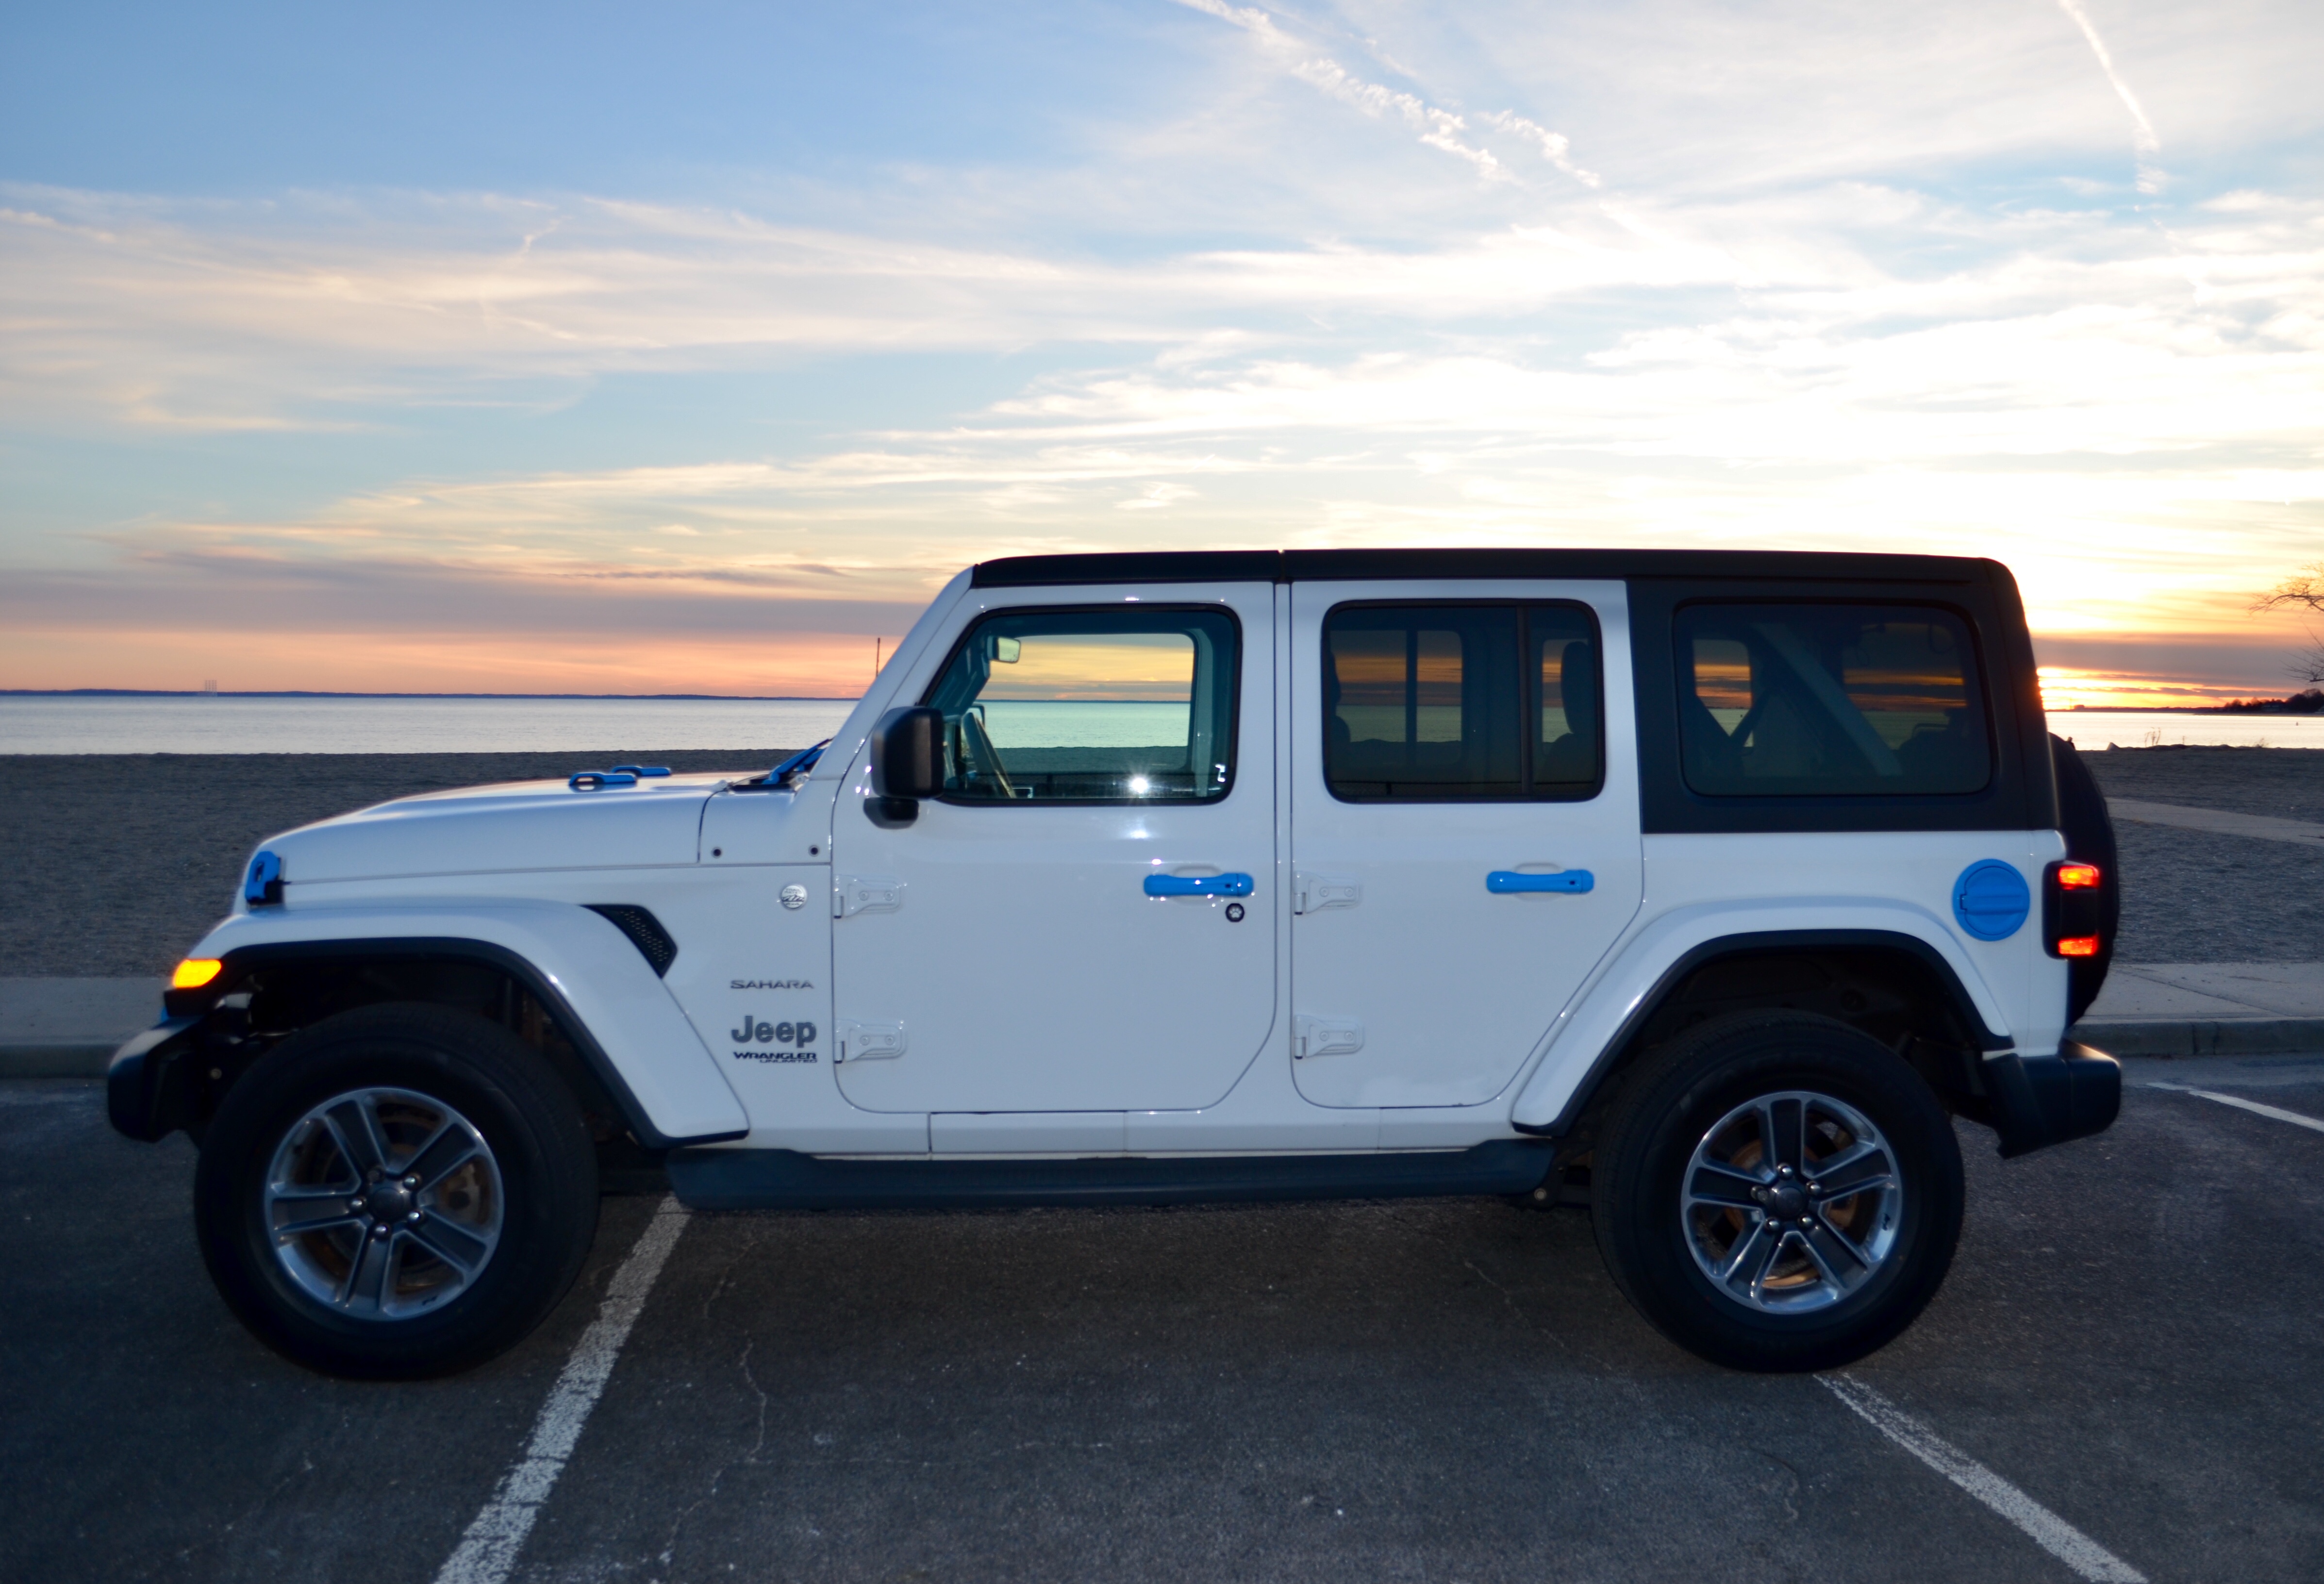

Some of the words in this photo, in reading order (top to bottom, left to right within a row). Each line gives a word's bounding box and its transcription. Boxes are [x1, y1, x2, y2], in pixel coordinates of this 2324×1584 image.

[730, 980, 814, 989] SAHARA
[731, 1016, 816, 1049] Jeep
[733, 1051, 816, 1060] WRANGLER
